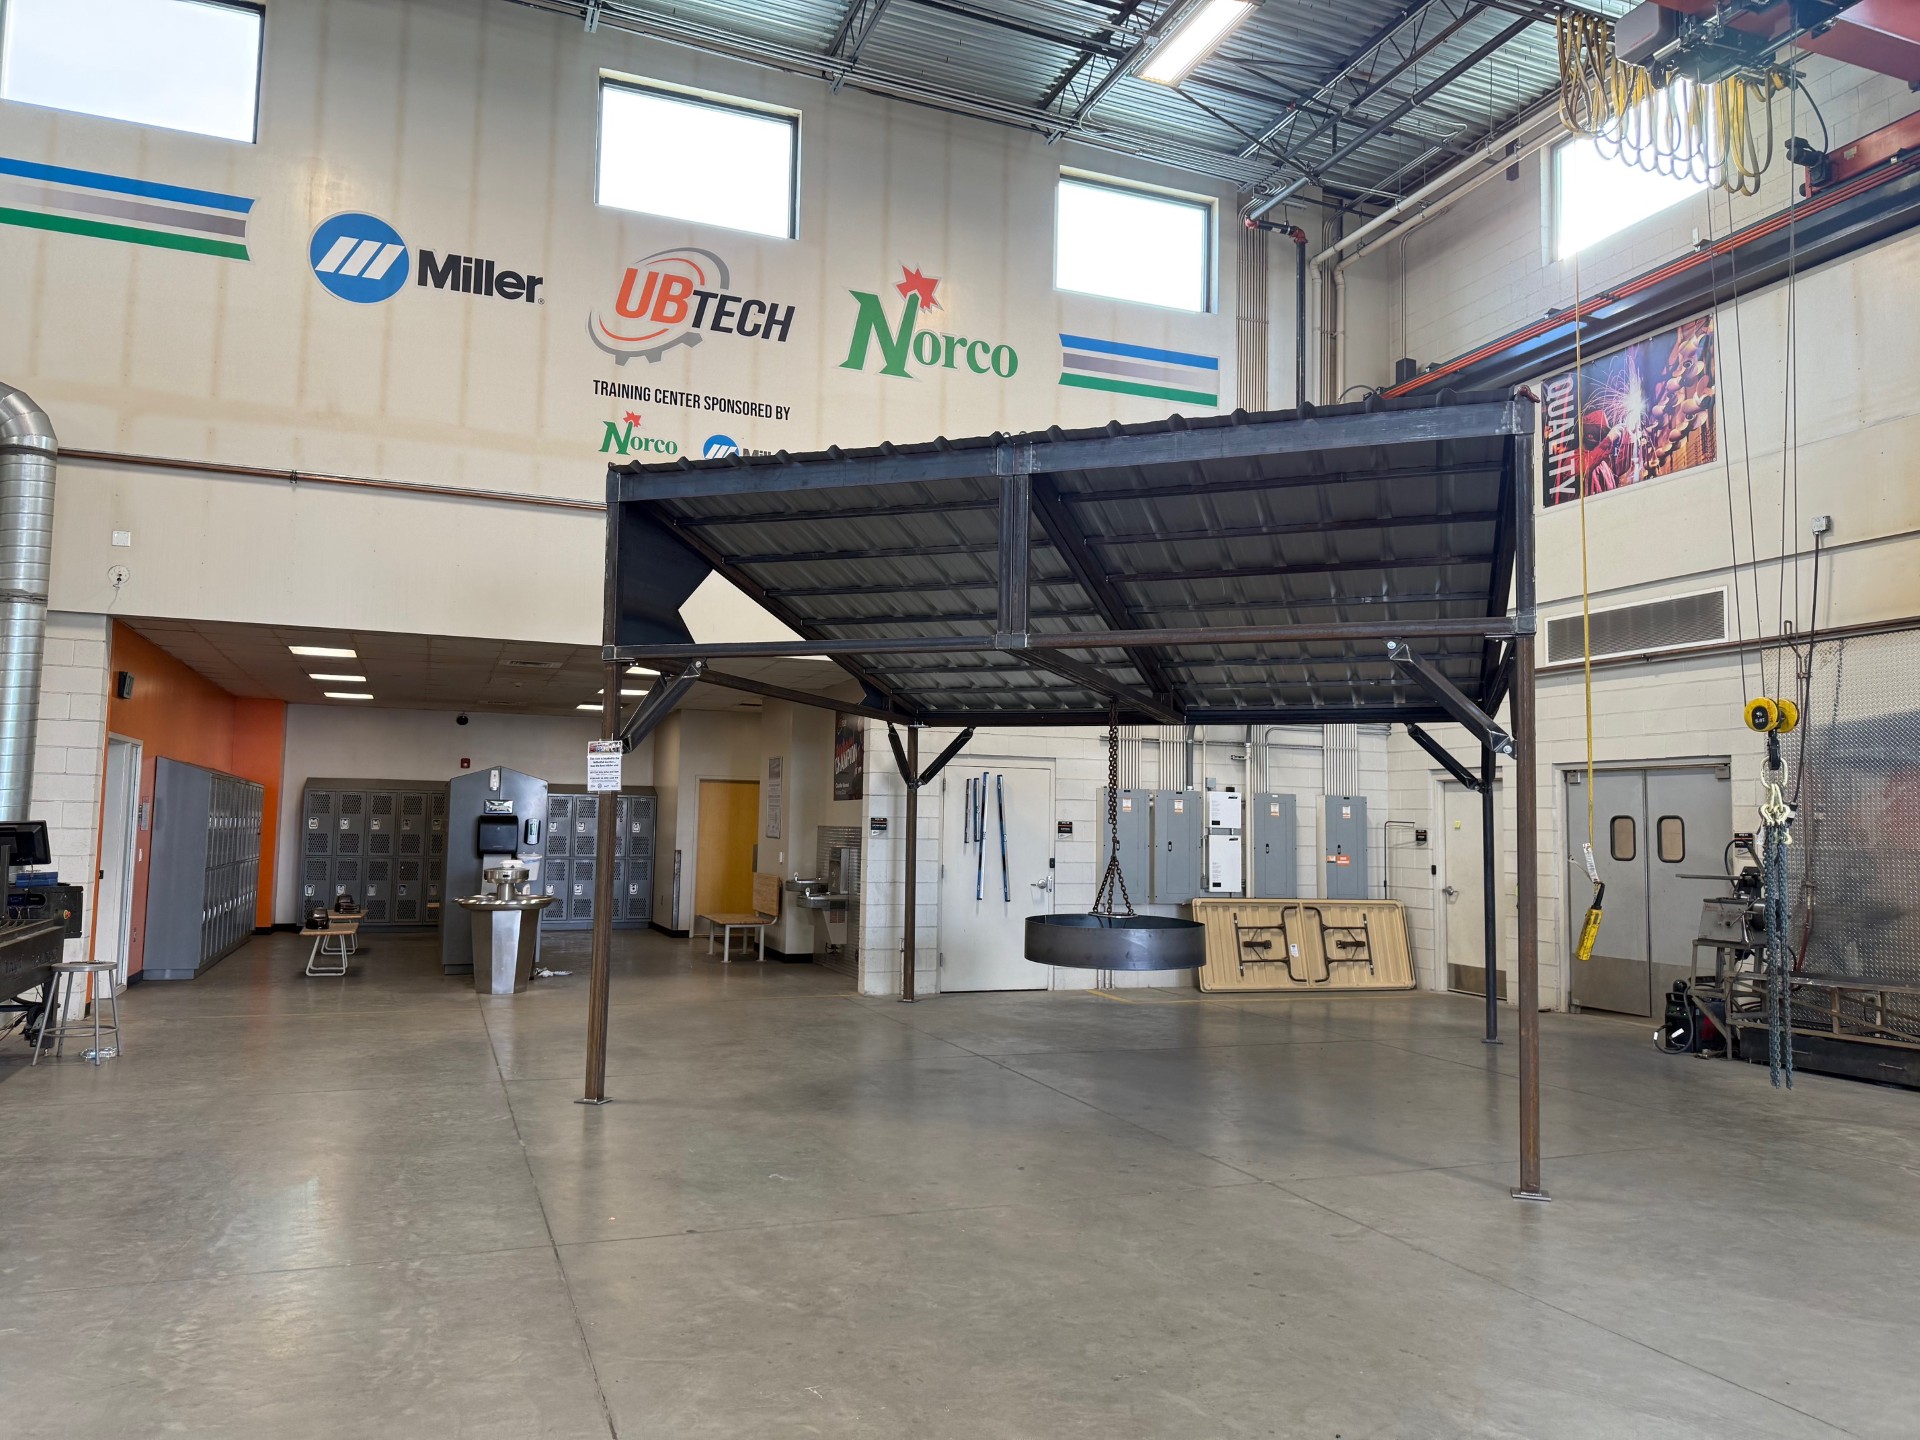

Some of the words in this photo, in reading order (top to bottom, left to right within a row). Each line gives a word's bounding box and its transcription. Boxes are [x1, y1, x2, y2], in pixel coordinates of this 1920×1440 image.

[418, 249, 544, 304] Miller
[838, 289, 1019, 379] Norco
[593, 379, 651, 402] TRAINING
[654, 388, 701, 409] CENTER
[704, 395, 772, 419] SPONSORED
[776, 405, 791, 421] BY
[598, 420, 678, 456] Norco
[1546, 377, 1576, 495] QUALITY
